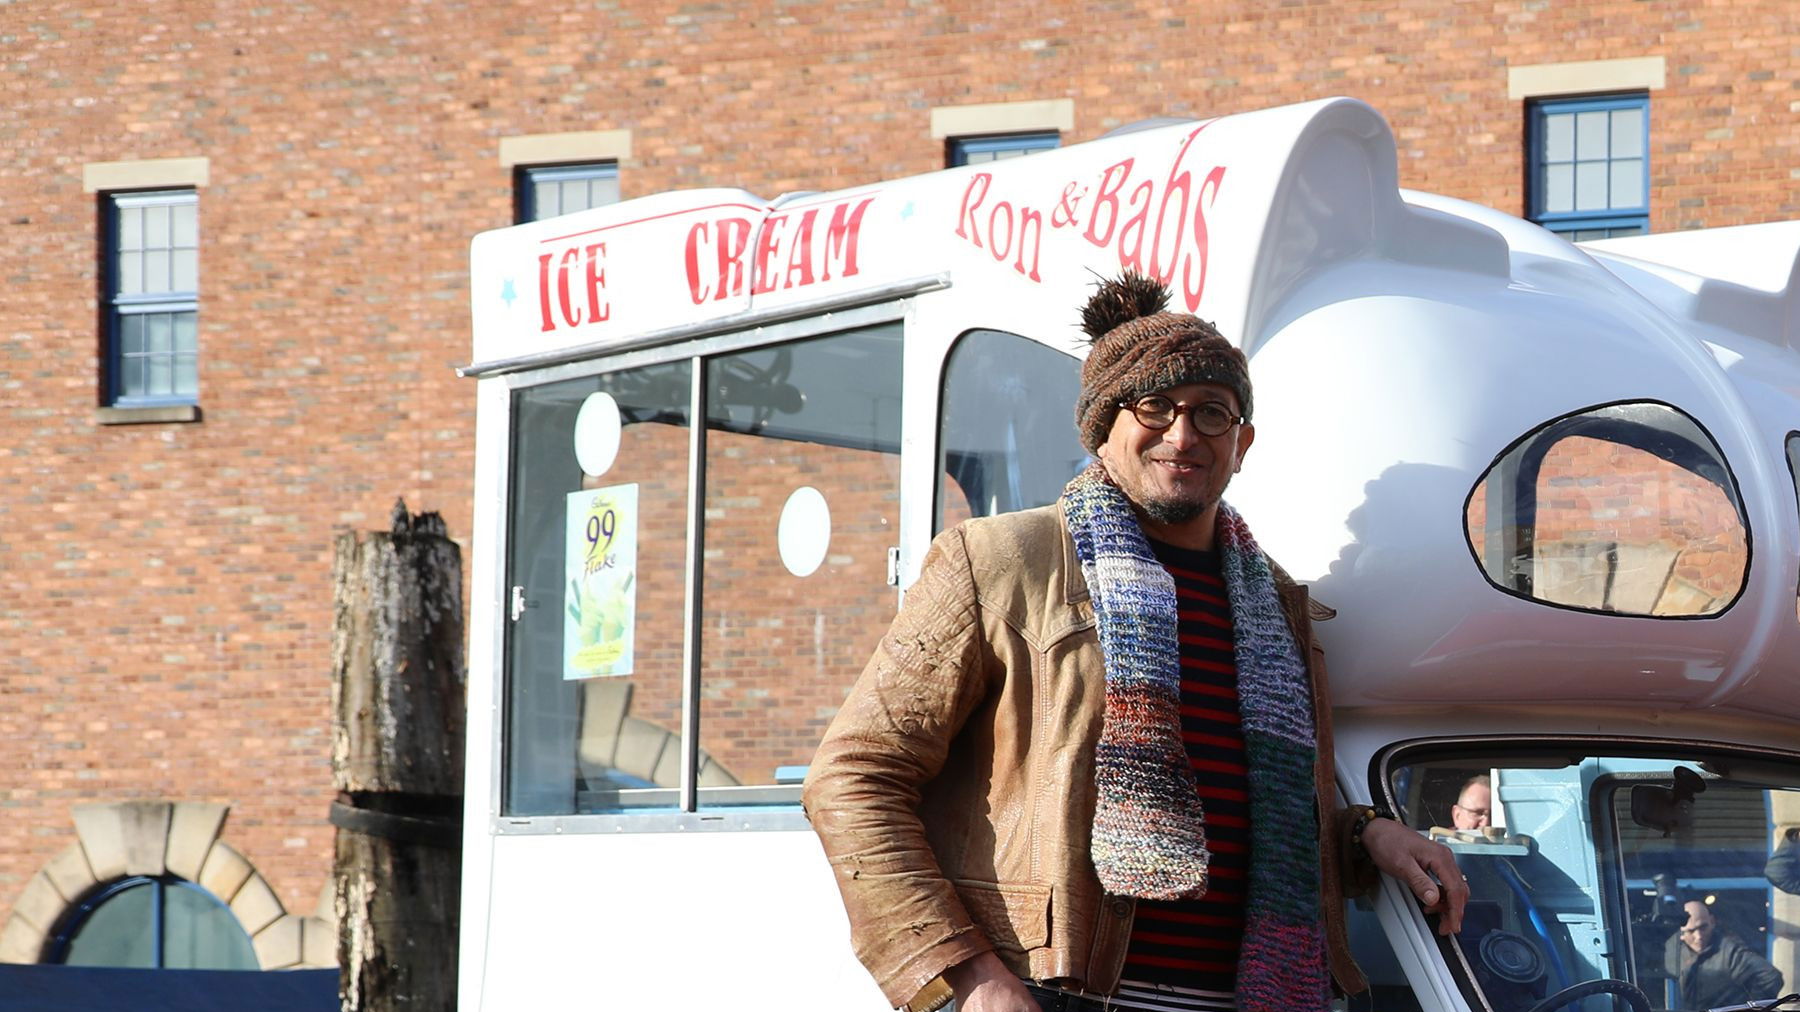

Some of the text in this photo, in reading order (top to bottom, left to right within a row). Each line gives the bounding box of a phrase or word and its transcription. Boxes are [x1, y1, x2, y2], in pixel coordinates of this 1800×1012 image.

[955, 172, 1042, 283] Ron
[1083, 117, 1227, 313] Babs
[538, 197, 876, 332] ICE CREAM
[583, 553, 617, 581] Flake
[586, 509, 616, 558] 99
